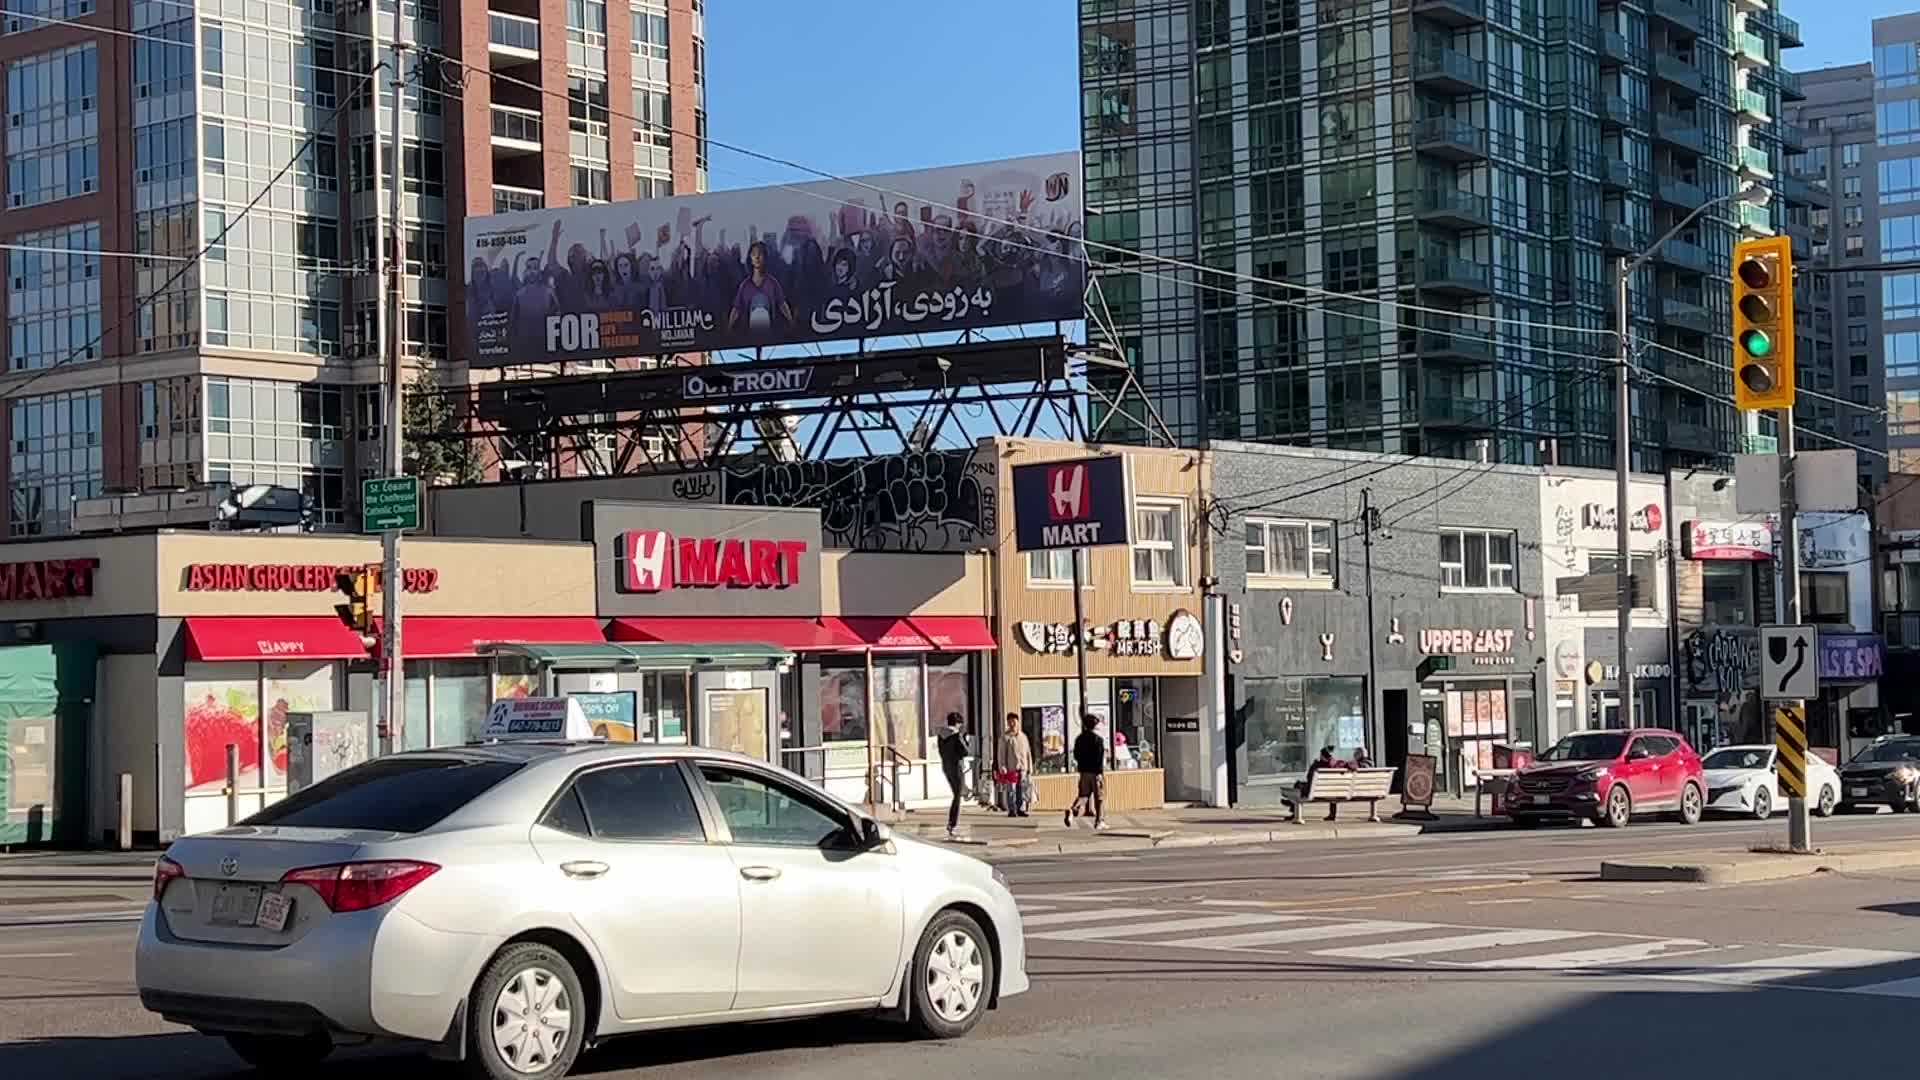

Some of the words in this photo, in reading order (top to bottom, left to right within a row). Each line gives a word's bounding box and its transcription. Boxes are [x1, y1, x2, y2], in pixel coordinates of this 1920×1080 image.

[645, 309, 709, 330] WILLIAM
[811, 281, 897, 333] آزادی
[546, 313, 600, 351] FOR
[1052, 464, 1083, 518] H
[1042, 522, 1101, 546] MART
[188, 564, 249, 590] ASIAN
[252, 565, 337, 590] GROCERY
[632, 531, 667, 589] H
[677, 537, 807, 587] MART
[1420, 629, 1473, 652] UPPER
[1475, 629, 1513, 652] EAST
[1856, 643, 1884, 677] SPA
